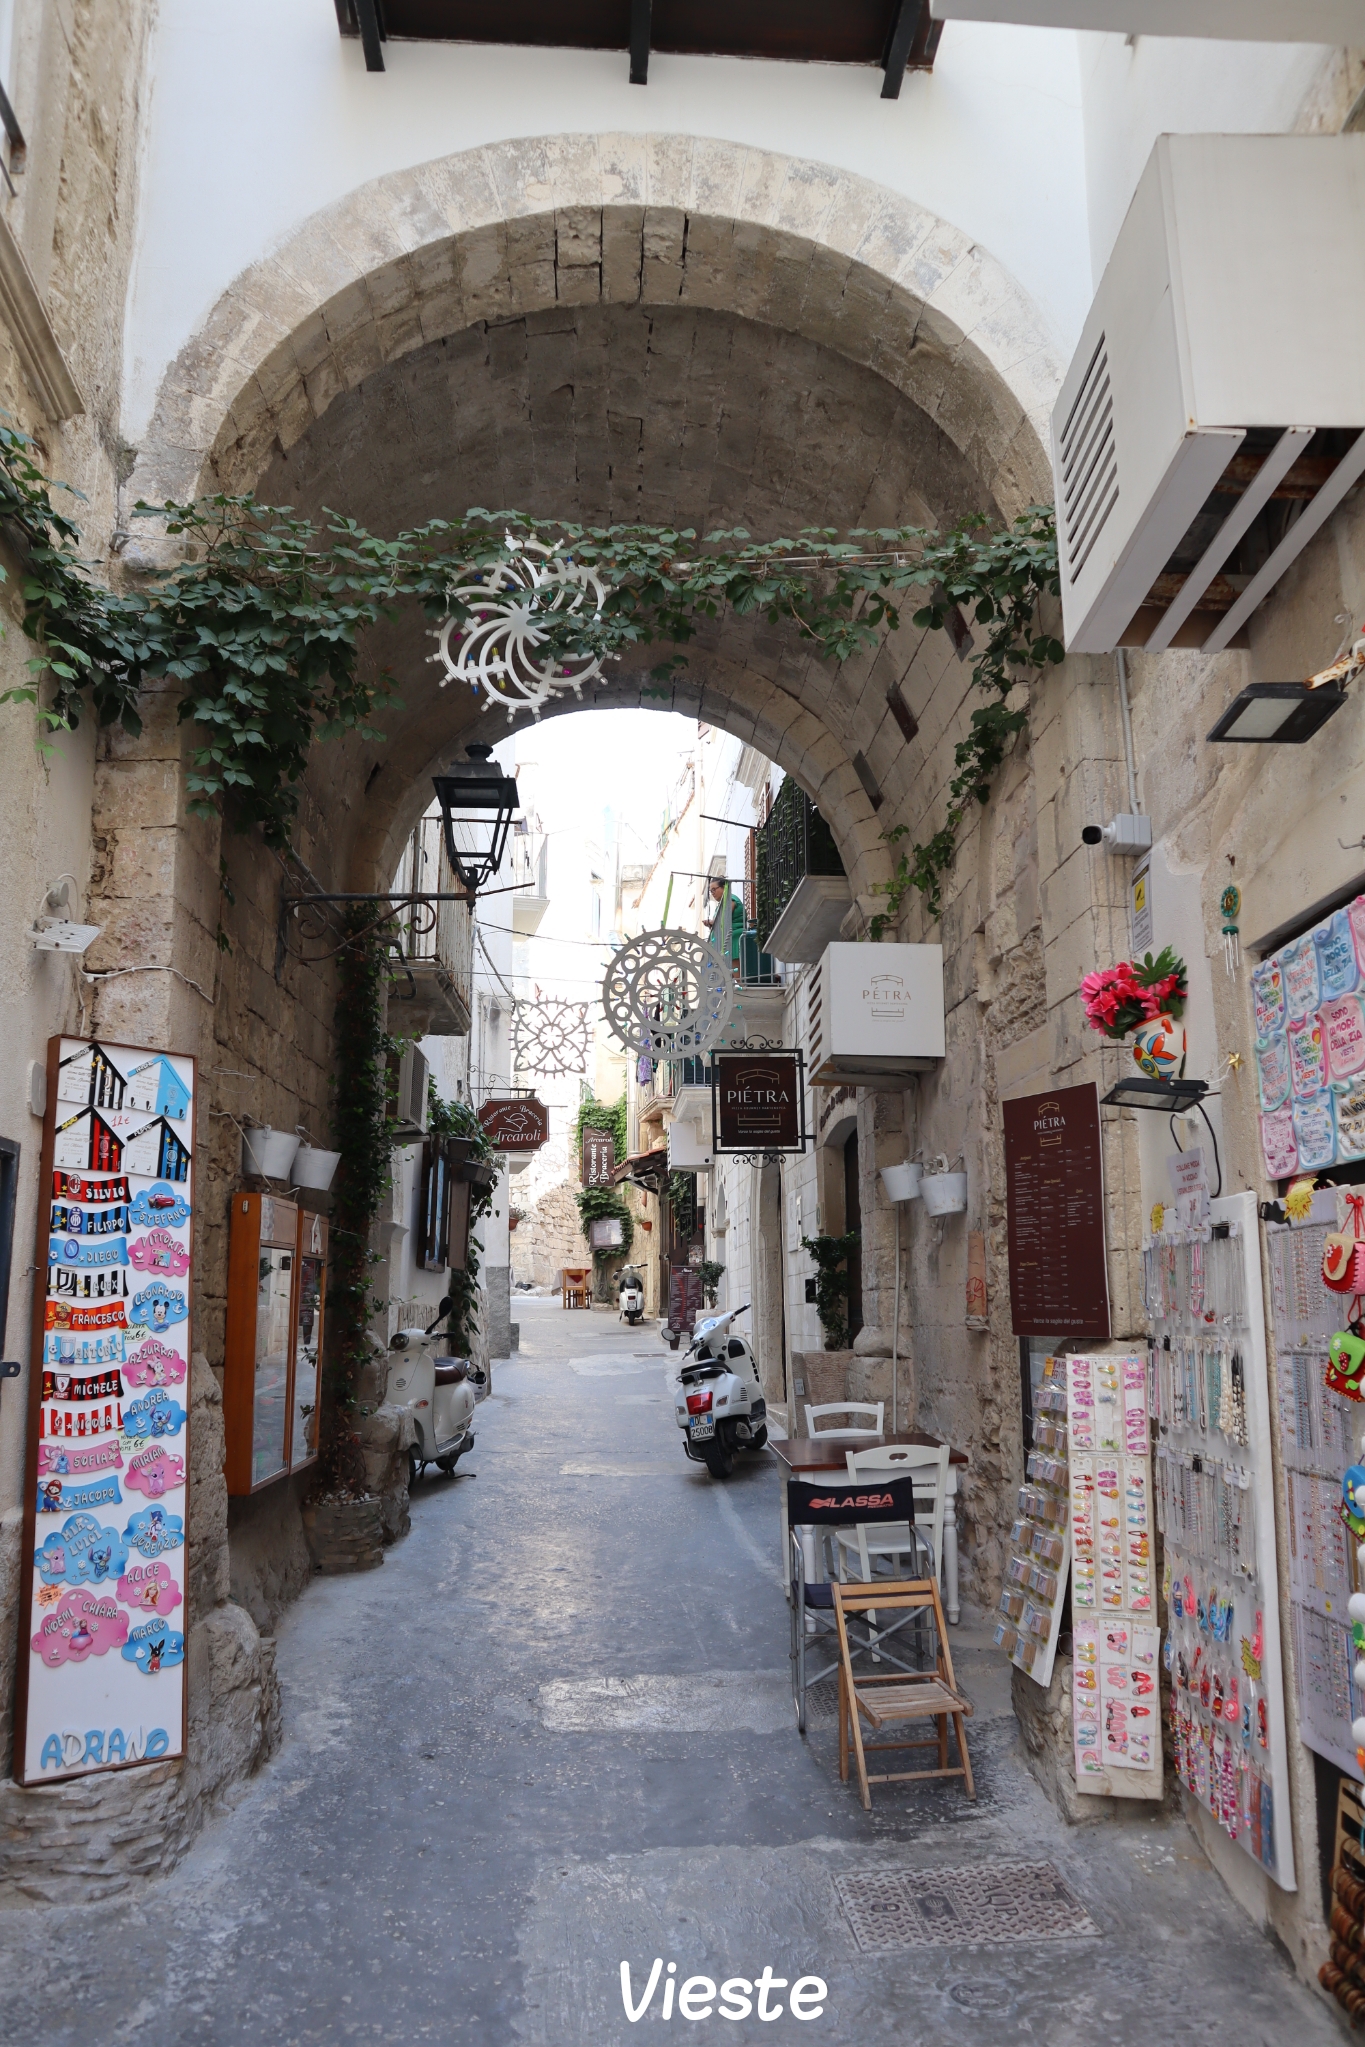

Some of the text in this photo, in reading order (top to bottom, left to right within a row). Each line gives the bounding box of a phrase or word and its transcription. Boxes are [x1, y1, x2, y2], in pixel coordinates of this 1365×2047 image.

[862, 987, 912, 1001] PÉTRA
[727, 1085, 790, 1103] PIÉTRA
[482, 1105, 512, 1128] Ristorante
[519, 1104, 543, 1127] Braceria
[1033, 1115, 1067, 1131] PIÉTRA
[492, 1129, 542, 1142] Arcaroli
[589, 1143, 600, 1186] Ristorante
[600, 1146, 610, 1184] Braceria
[86, 1186, 125, 1200] SILVIO
[87, 1217, 125, 1233] FILIPPO
[139, 1207, 187, 1225] STEFANO
[141, 1231, 185, 1257] VITTORIA
[87, 1250, 119, 1263] DIEGO
[92, 1279, 118, 1293] ALEX
[134, 1284, 183, 1306] LEONARDO
[72, 1311, 125, 1325] FRANCESCO
[74, 1339, 122, 1360] ANTONIO
[129, 1342, 175, 1365] AZZURRA
[73, 1380, 118, 1396] MICHELE
[131, 1391, 170, 1416] ANDREA
[73, 1414, 112, 1431] NICOLA
[73, 1453, 107, 1468] SOFIA
[131, 1446, 167, 1470] MIRIAM
[74, 1487, 115, 1506] JACOPO
[830, 1493, 894, 1508] LASSA
[62, 1518, 85, 1542] MIA
[69, 1529, 103, 1557] LUIGI
[131, 1533, 178, 1554] LORENZO
[127, 1564, 160, 1585] ALICE
[82, 1600, 119, 1619] CHIARA
[43, 1607, 75, 1637] NOEMI
[132, 1618, 166, 1641] MARCO
[40, 1725, 170, 1770] ADRIANO
[977, 1882, 1019, 1916] AQP
